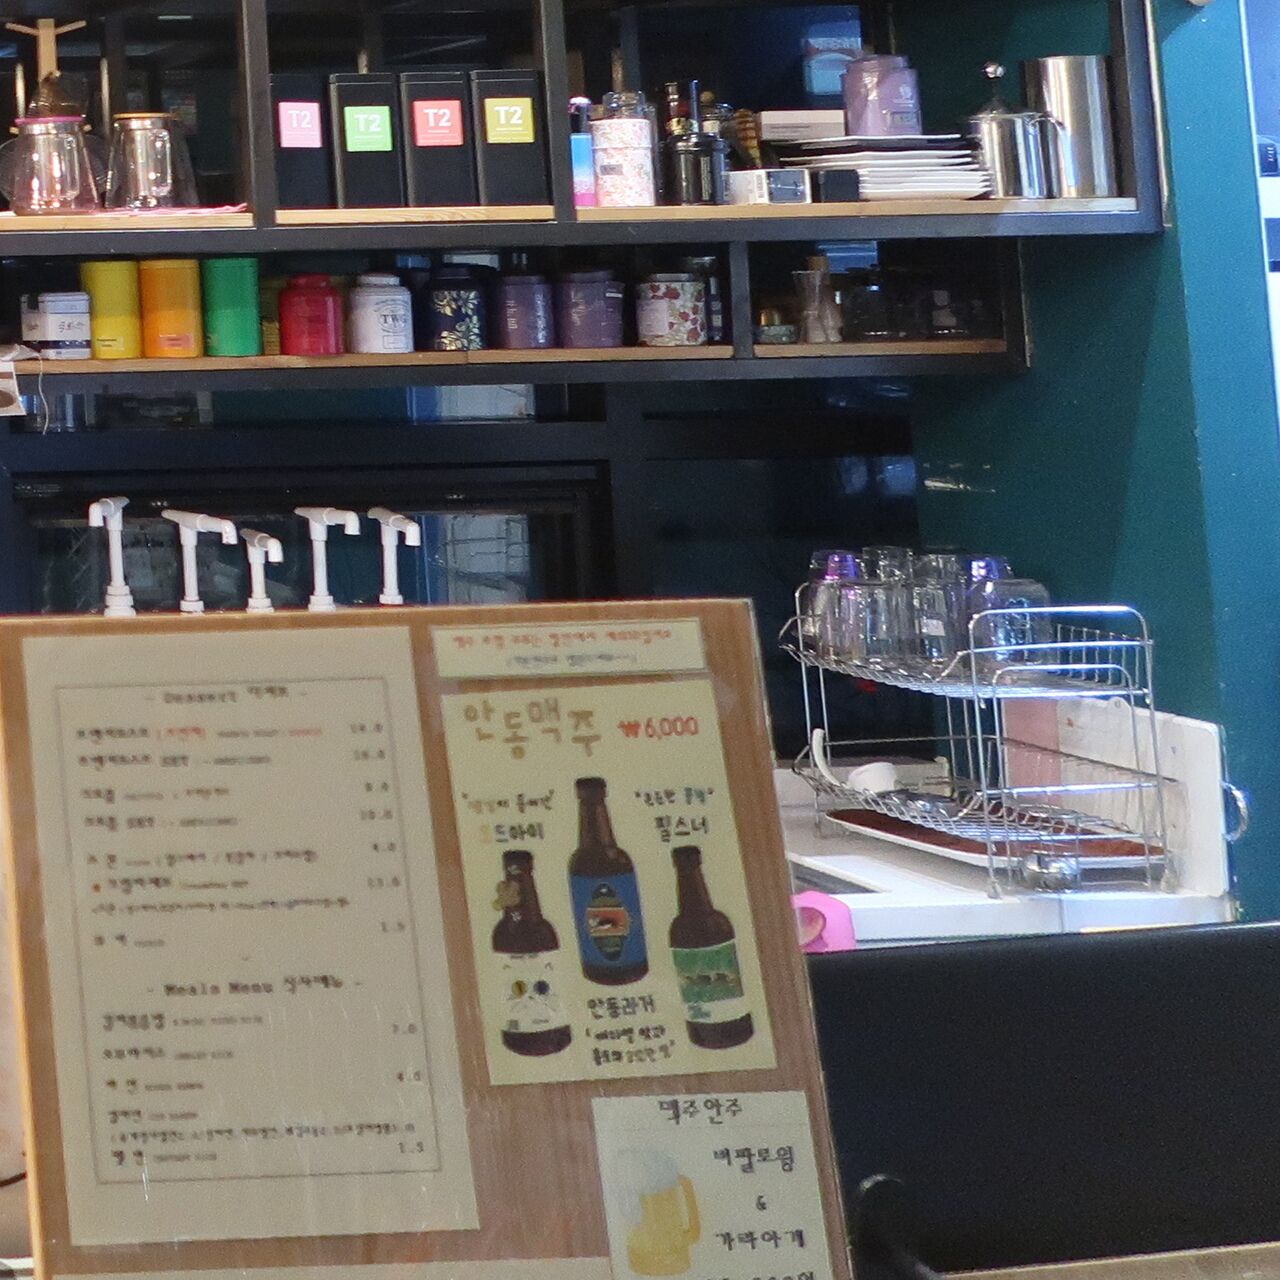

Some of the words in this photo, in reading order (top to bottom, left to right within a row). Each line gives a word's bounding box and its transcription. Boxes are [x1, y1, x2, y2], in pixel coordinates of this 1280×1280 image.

[288, 110, 312, 129] T2
[354, 114, 382, 132] T2
[423, 108, 452, 127] T2
[494, 106, 523, 124] T2
